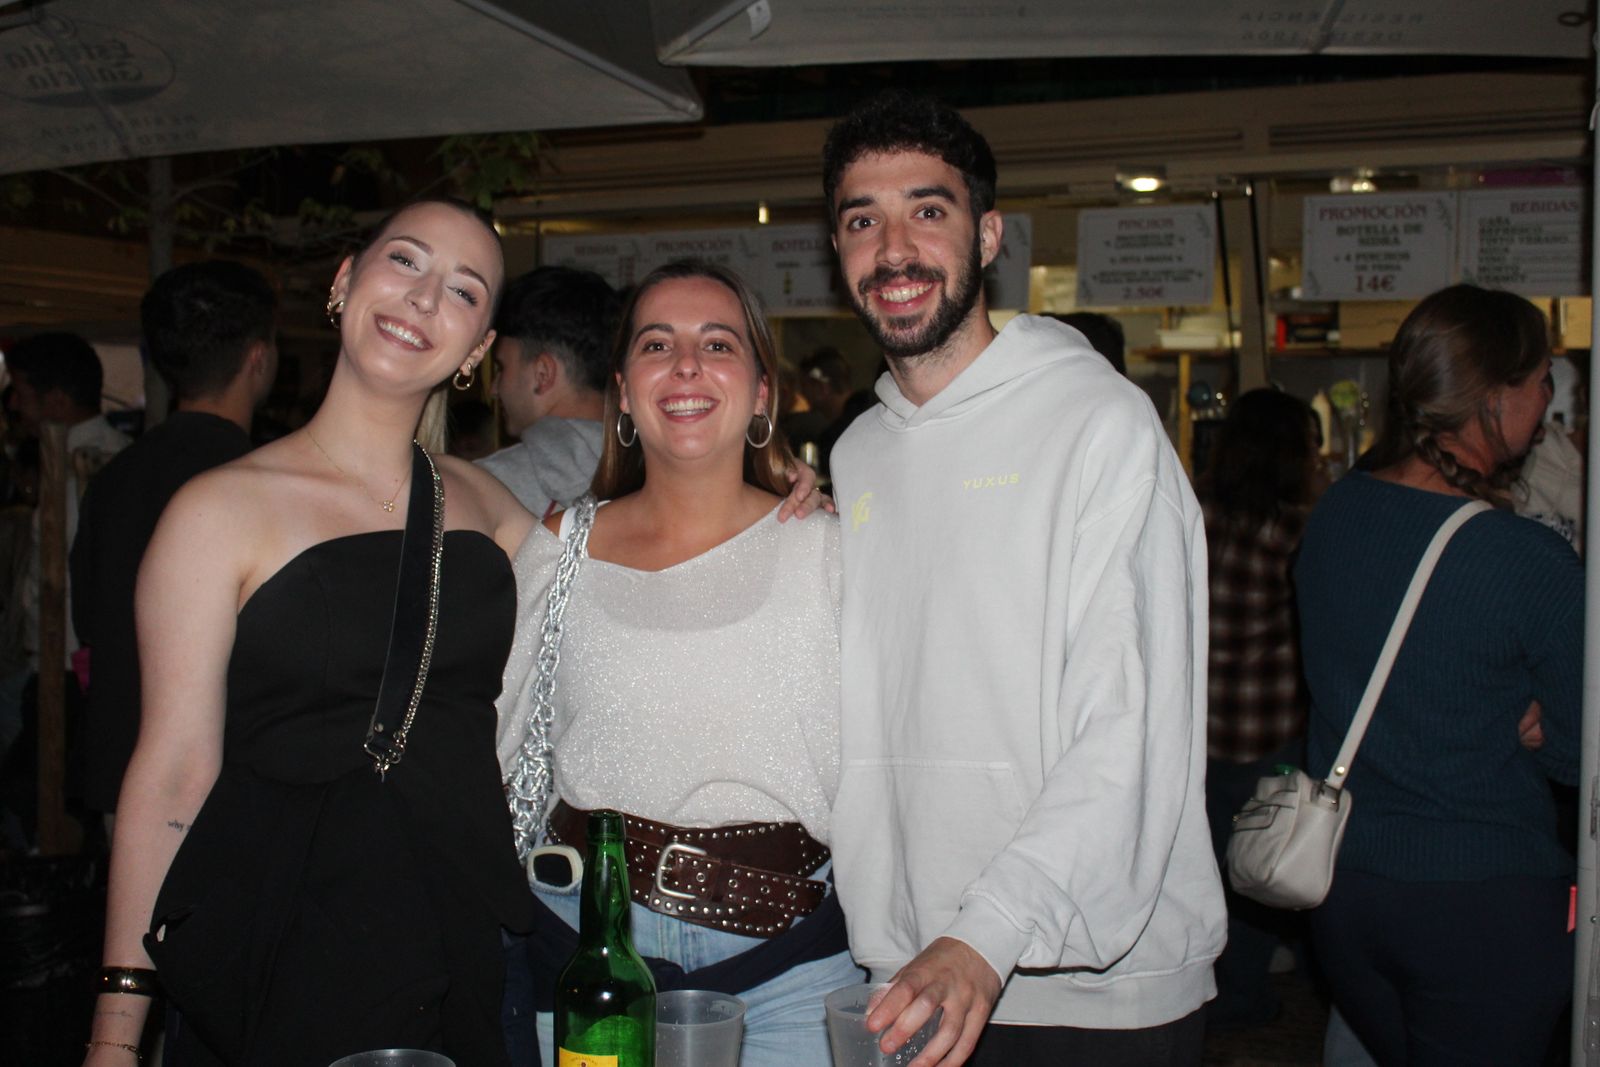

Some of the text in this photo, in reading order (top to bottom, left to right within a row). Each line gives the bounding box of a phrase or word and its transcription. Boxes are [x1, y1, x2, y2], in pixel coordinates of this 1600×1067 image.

[1319, 204, 1427, 221] PROMOCIÓN
[1510, 200, 1580, 214] BEBIDAS
[1336, 224, 1399, 236] BOTELLA
[1356, 273, 1396, 292] 14€
[961, 472, 1022, 491] YUXUS
